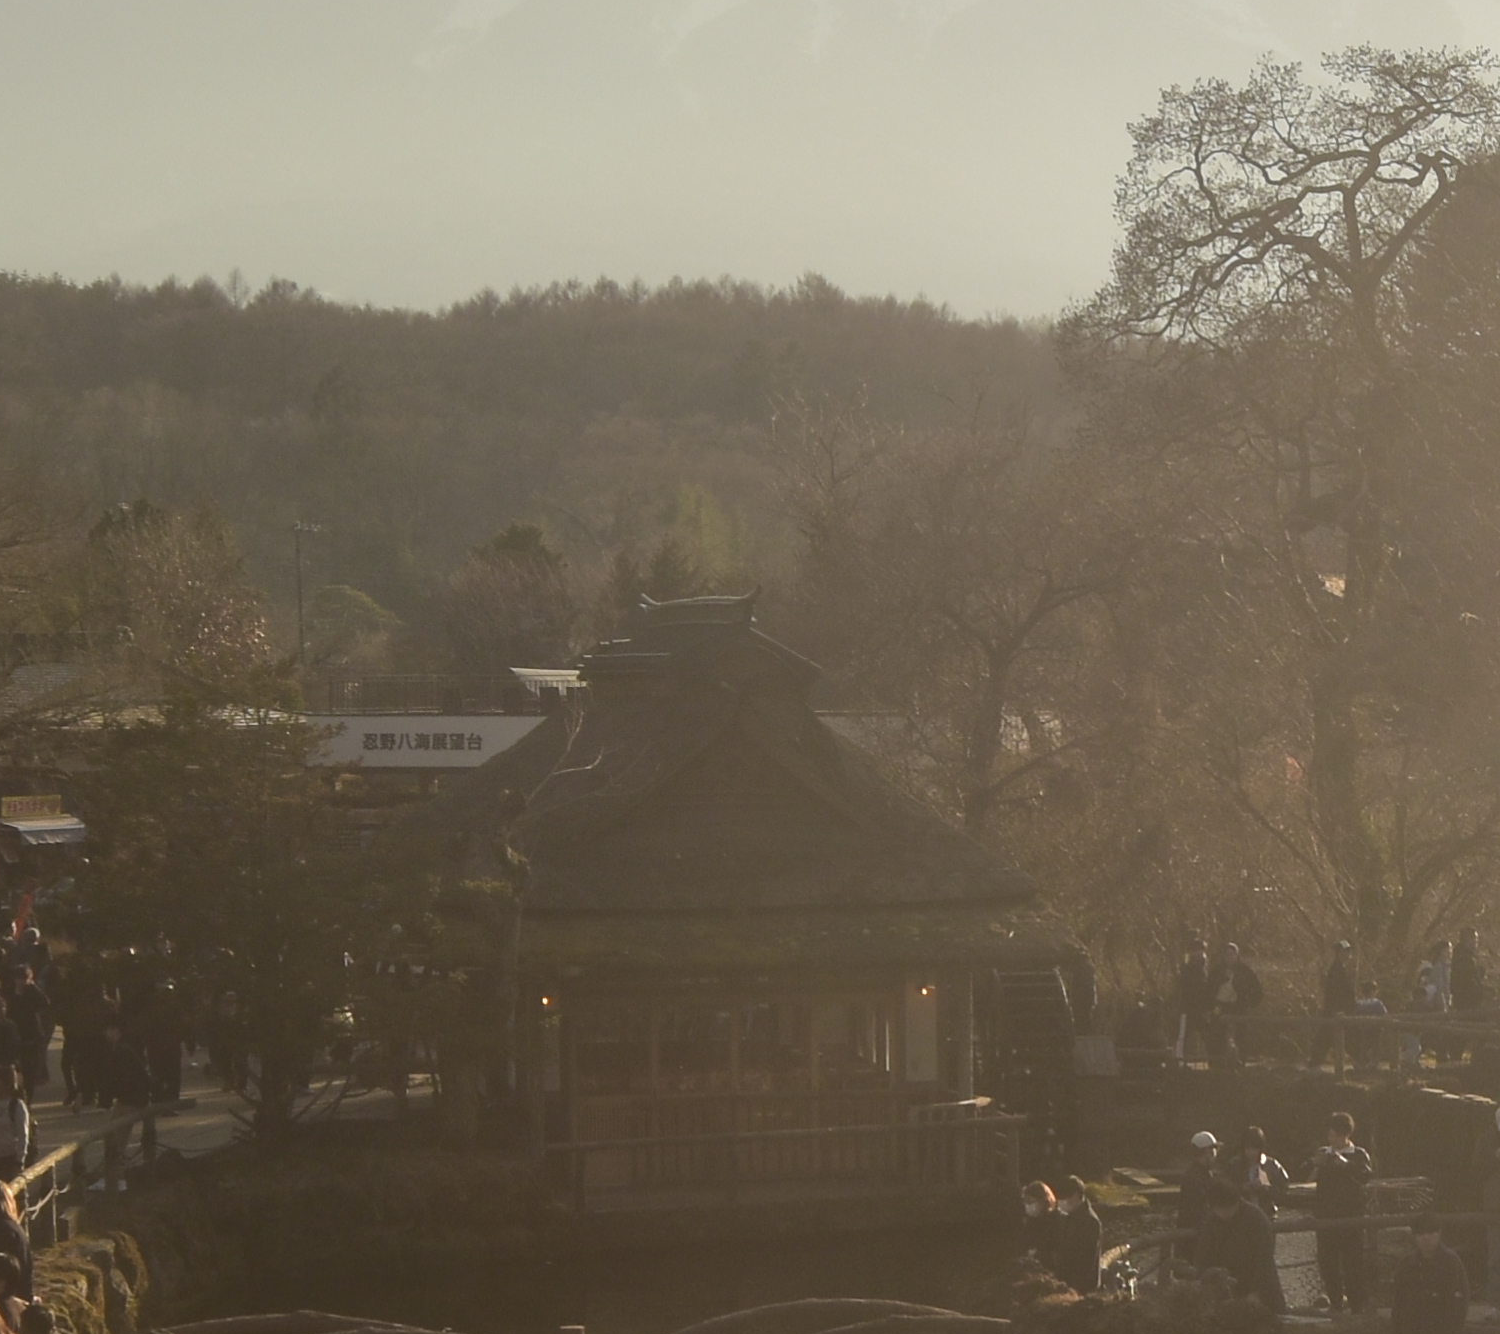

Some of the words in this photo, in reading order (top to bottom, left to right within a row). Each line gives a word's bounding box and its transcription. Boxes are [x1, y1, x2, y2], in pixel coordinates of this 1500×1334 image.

[364, 733, 482, 750] 忍野八海展望台
